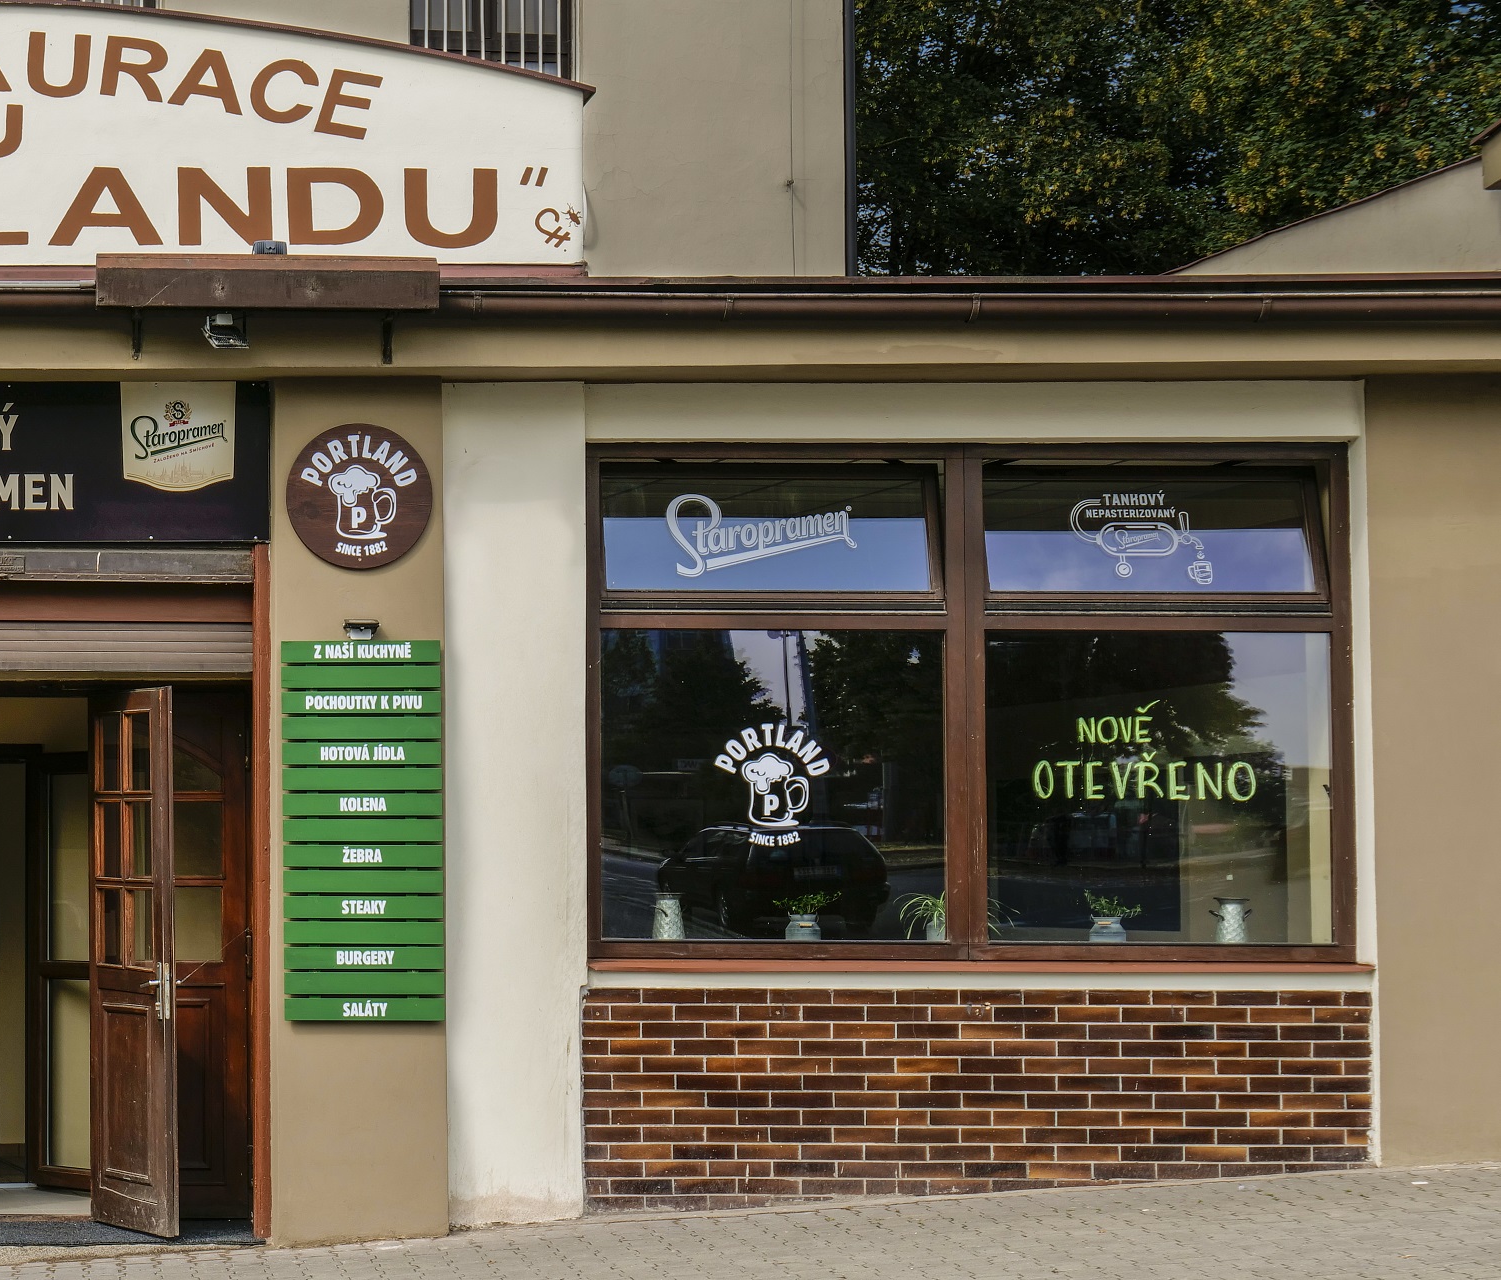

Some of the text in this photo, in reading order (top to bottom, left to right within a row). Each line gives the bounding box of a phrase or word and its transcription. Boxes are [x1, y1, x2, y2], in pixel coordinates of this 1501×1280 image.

[130, 415, 228, 460] Staropramen
[300, 434, 418, 488] PORTLAND
[1102, 490, 1165, 506] TANKOVÝ
[351, 506, 367, 529] P
[1085, 506, 1176, 519] NEPASTERIZOVANÝ
[665, 493, 858, 578] Staropramen
[335, 540, 388, 557] SINCE 1882
[314, 641, 412, 659] Z NAŠÍ KUCHYNĚ
[305, 695, 423, 710] POCHOUTKY K PIVU
[320, 743, 405, 761] HOTOVÁ JÍDLA
[714, 723, 830, 776] PORTLAND
[1032, 751, 1257, 801] OTEVŘENO
[339, 797, 387, 812] KOLENA
[764, 794, 780, 816] P
[748, 831, 801, 847] SINCE 1882
[342, 846, 383, 863] ŽEBRA
[341, 899, 387, 915] STEAKY
[336, 950, 395, 966] BURGERY
[342, 1000, 388, 1017] SALÁTY
